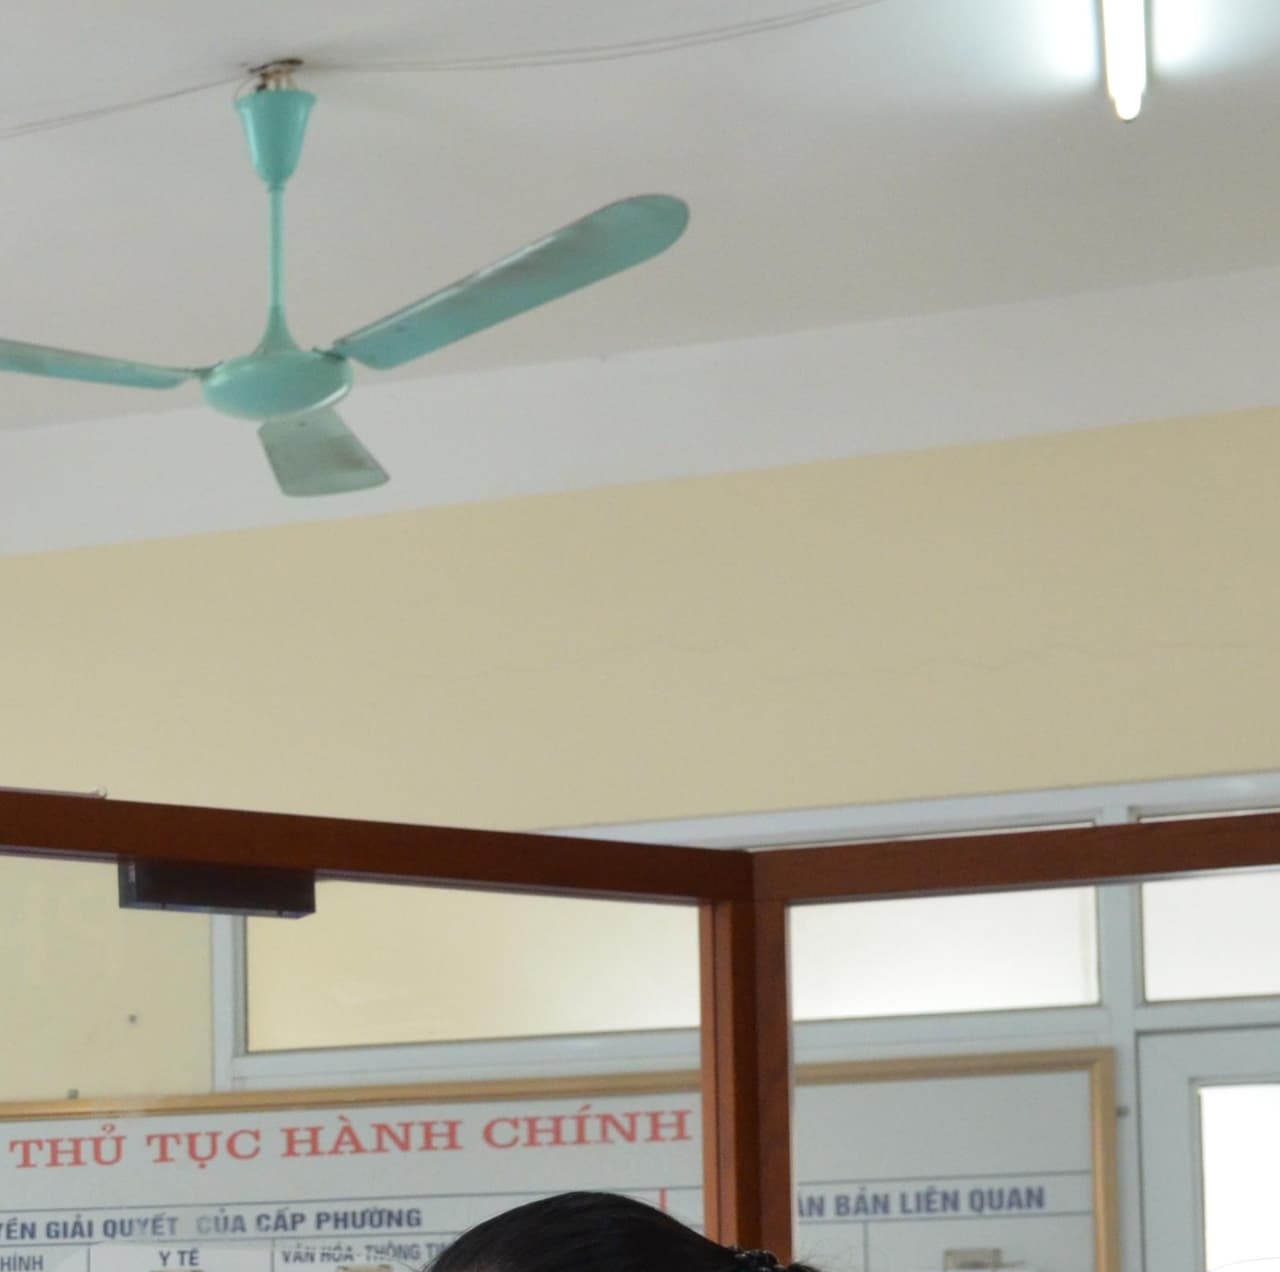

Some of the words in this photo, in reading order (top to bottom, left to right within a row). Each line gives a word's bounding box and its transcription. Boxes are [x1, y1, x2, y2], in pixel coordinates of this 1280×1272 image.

[10, 1124, 127, 1169] THỦ
[146, 1128, 261, 1169] TỤC
[281, 1115, 464, 1158] HÀNH
[483, 1105, 692, 1149] CHÍNH
[835, 1184, 889, 1217] BẢN
[901, 1185, 959, 1213] LIÊN
[968, 1185, 1045, 1214] QUAN
[46, 1208, 93, 1239] GIẢI
[103, 1211, 178, 1239] QUYẾT
[196, 1207, 246, 1235] CỦA
[256, 1208, 305, 1232] CẤP
[316, 1206, 422, 1231] PHƯỜNG
